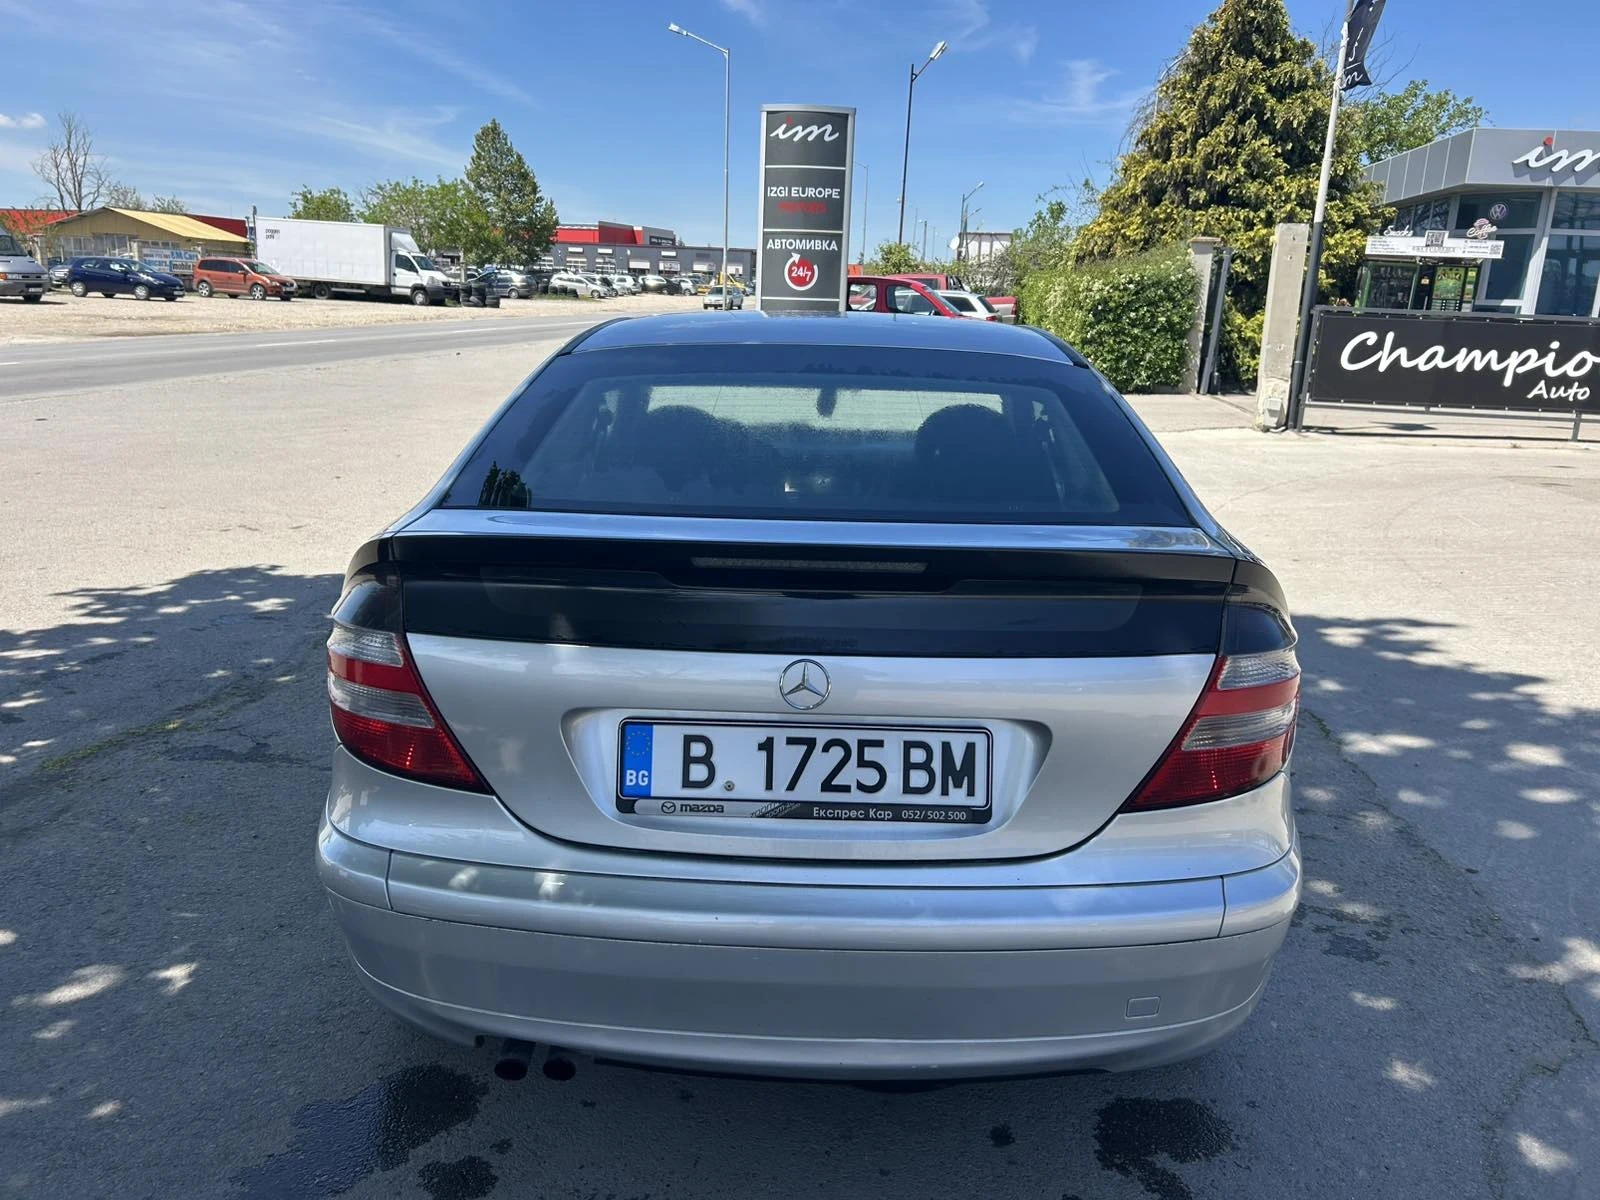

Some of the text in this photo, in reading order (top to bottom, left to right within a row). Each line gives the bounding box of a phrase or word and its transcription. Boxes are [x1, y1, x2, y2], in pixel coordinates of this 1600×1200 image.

[769, 116, 840, 142] im
[767, 186, 841, 199] IZGI EUROPE
[1466, 223, 1498, 238] Coffee
[766, 239, 838, 251] АВТОМИВКА
[791, 266, 812, 282] 24/7
[1526, 380, 1591, 402] Auto
[682, 734, 976, 797] B 1725 BM
[625, 770, 649, 786] BG
[679, 803, 725, 813] mazda
[813, 807, 966, 820] Експрес Кар 052/ 502 500
